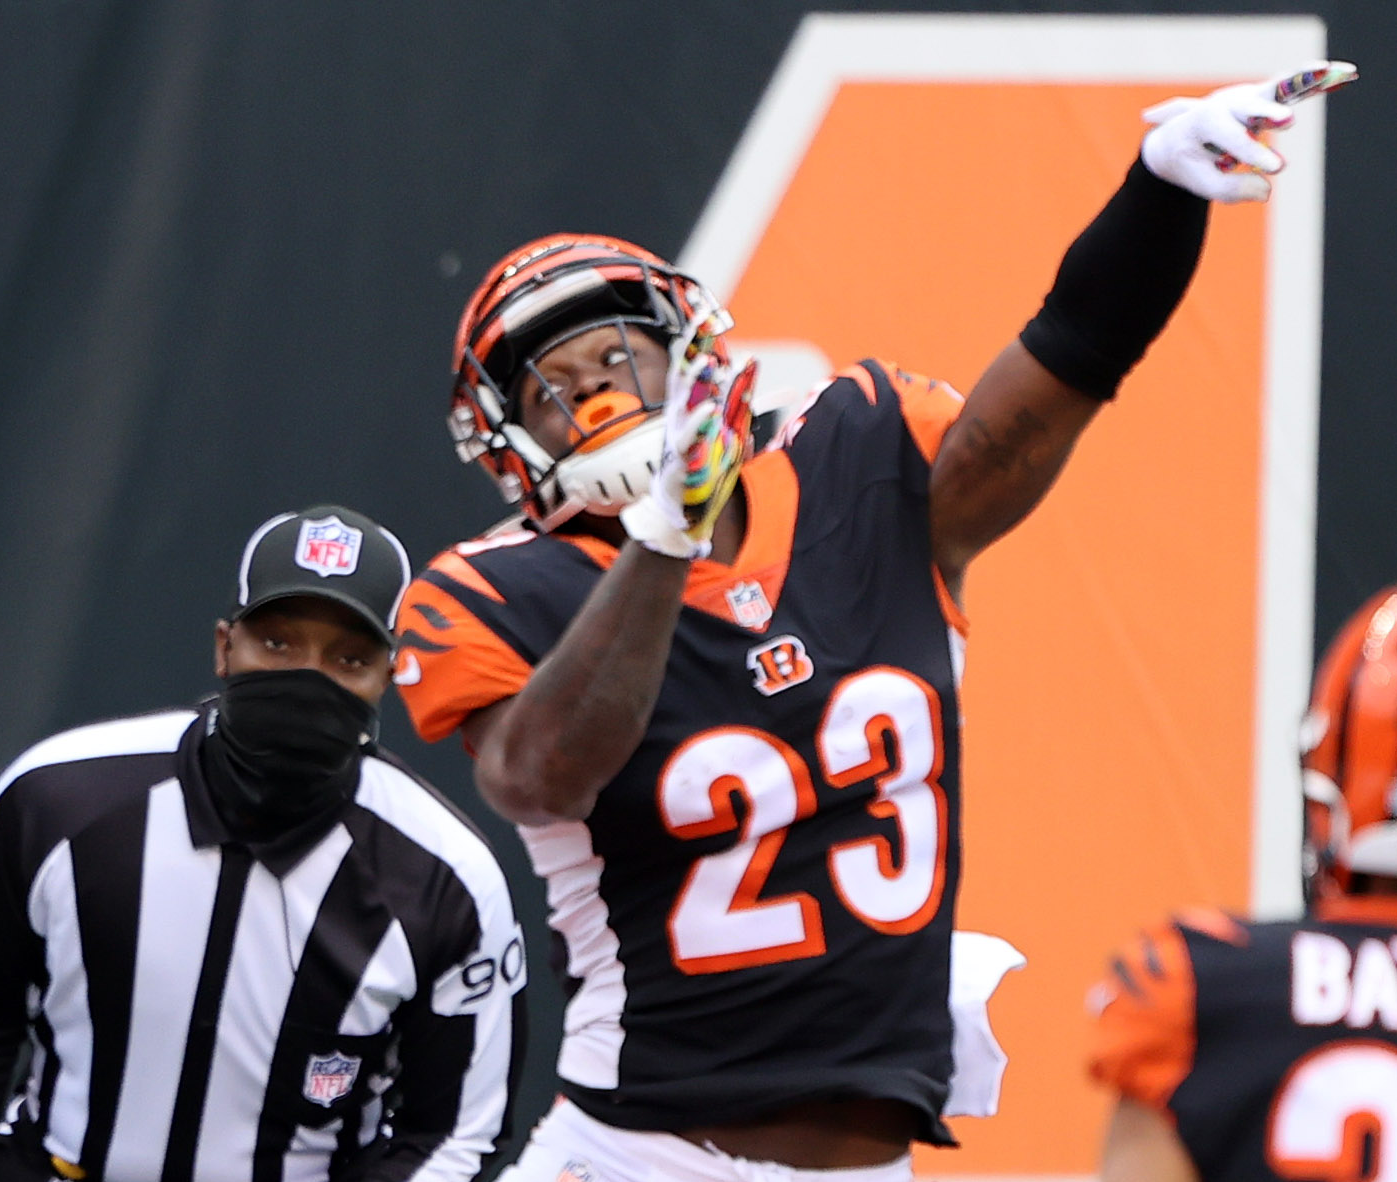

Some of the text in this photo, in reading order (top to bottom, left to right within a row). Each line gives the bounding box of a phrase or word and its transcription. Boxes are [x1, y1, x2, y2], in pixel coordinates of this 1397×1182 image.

[306, 540, 351, 569] NFL
[657, 664, 949, 976] 23
[460, 937, 523, 1006] 90
[1289, 929, 1397, 1031] BA
[311, 1074, 351, 1099] NFL
